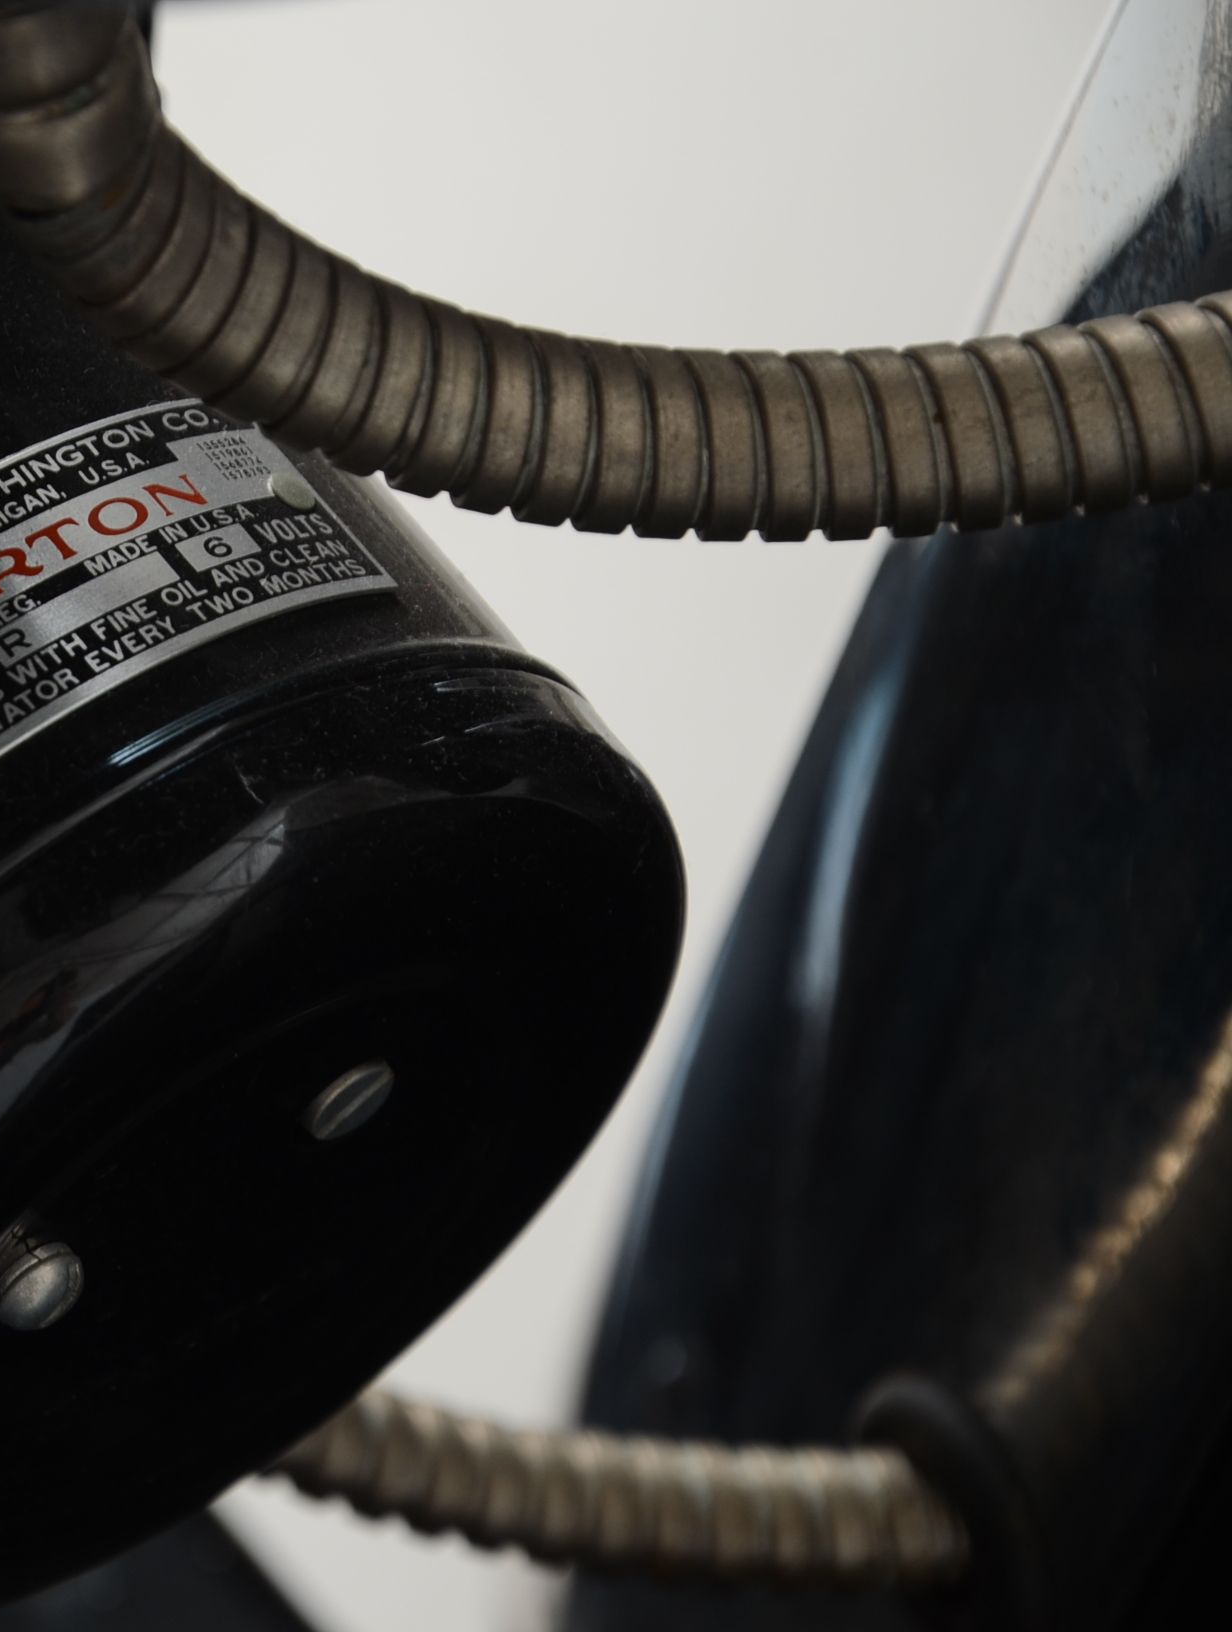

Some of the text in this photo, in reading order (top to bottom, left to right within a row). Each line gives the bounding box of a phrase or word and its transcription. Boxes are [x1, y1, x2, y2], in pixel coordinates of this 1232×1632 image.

[162, 408, 219, 430] CO.
[79, 452, 150, 486] U.S.A.
[83, 506, 260, 577] MADE IN U.S.A.
[203, 536, 232, 558] 6
[252, 513, 334, 544] VOLTS
[7, 632, 89, 685] WITH
[90, 599, 158, 640] FINE
[161, 580, 208, 607] OIL
[211, 559, 264, 587] AND
[270, 540, 350, 568] CLEAN
[83, 615, 177, 673] EVERY
[185, 586, 254, 620] TWO
[260, 560, 365, 596] MONTHS
